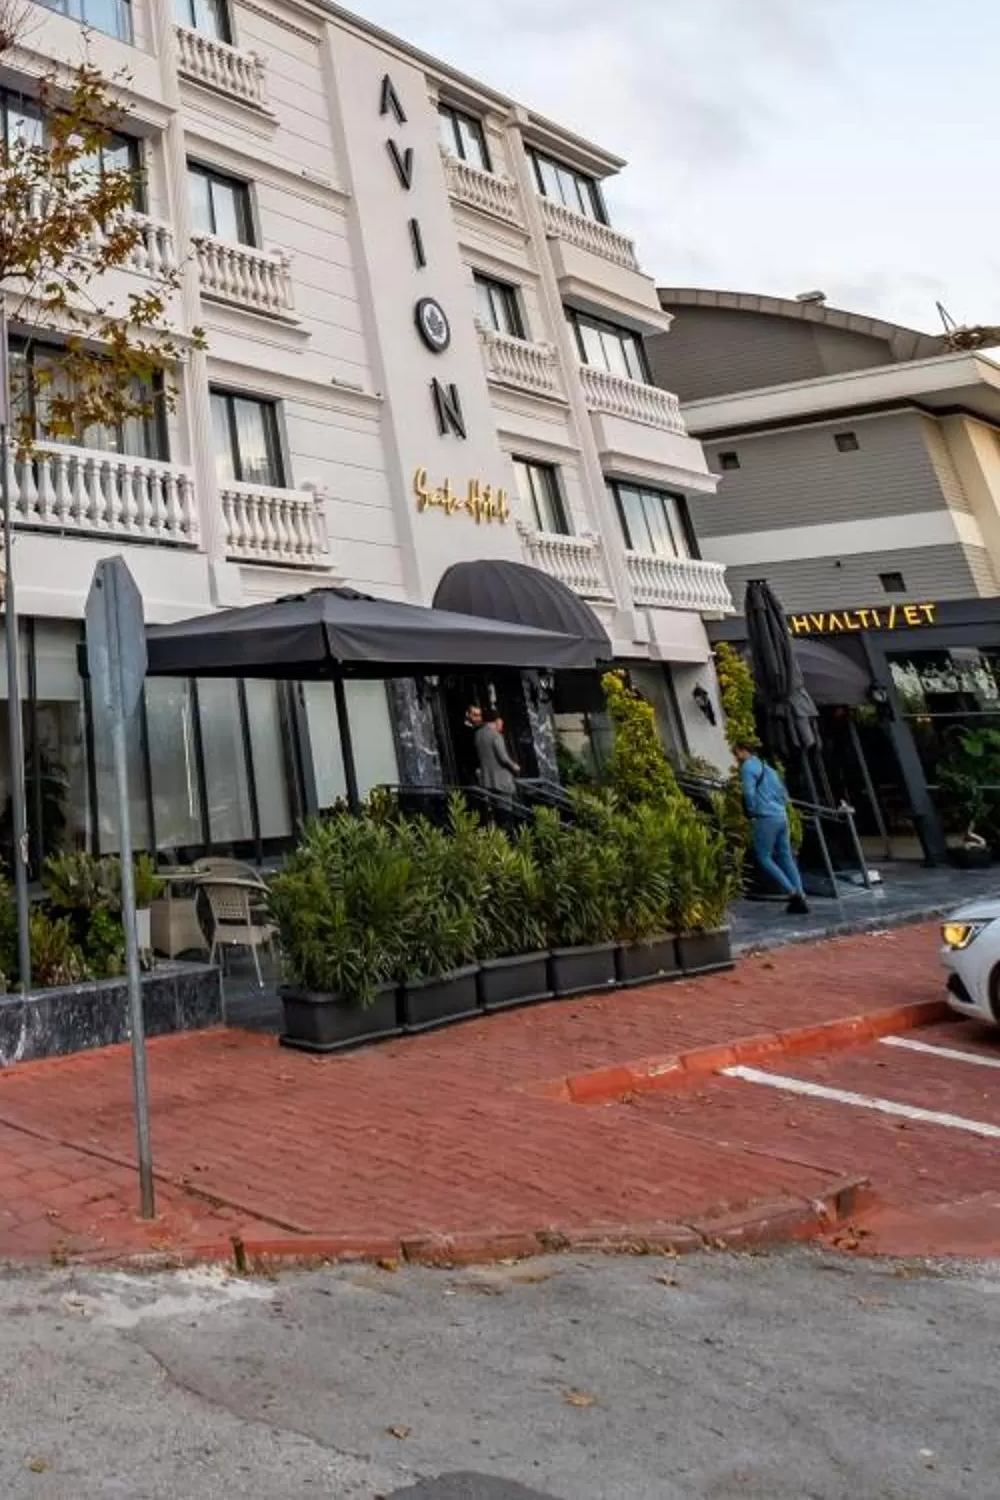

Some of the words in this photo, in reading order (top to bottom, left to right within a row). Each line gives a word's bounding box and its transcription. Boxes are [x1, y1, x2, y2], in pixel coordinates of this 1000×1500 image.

[379, 73, 467, 440] AVION
[788, 609, 881, 634] HVALTI
[903, 604, 935, 625] ET
